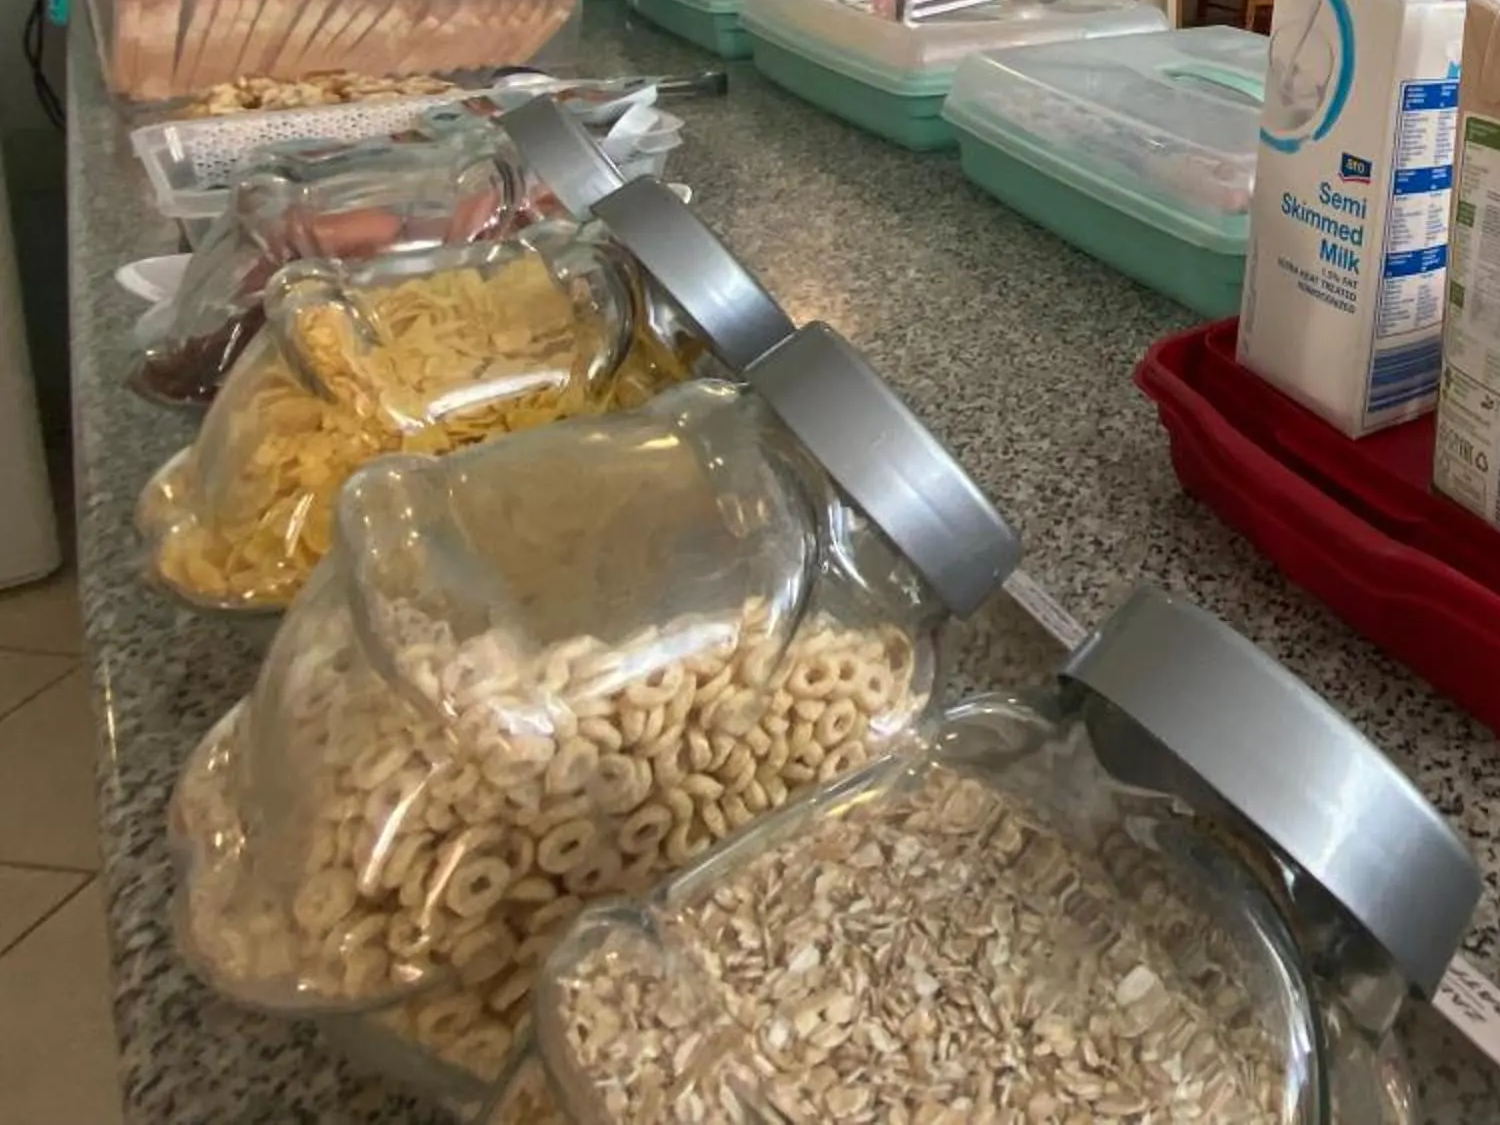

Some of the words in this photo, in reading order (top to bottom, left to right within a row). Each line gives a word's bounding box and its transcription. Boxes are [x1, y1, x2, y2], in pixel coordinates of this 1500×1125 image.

[1319, 182, 1367, 219] Semi
[1281, 192, 1364, 247] Skimmed
[1319, 239, 1360, 275] Milk
